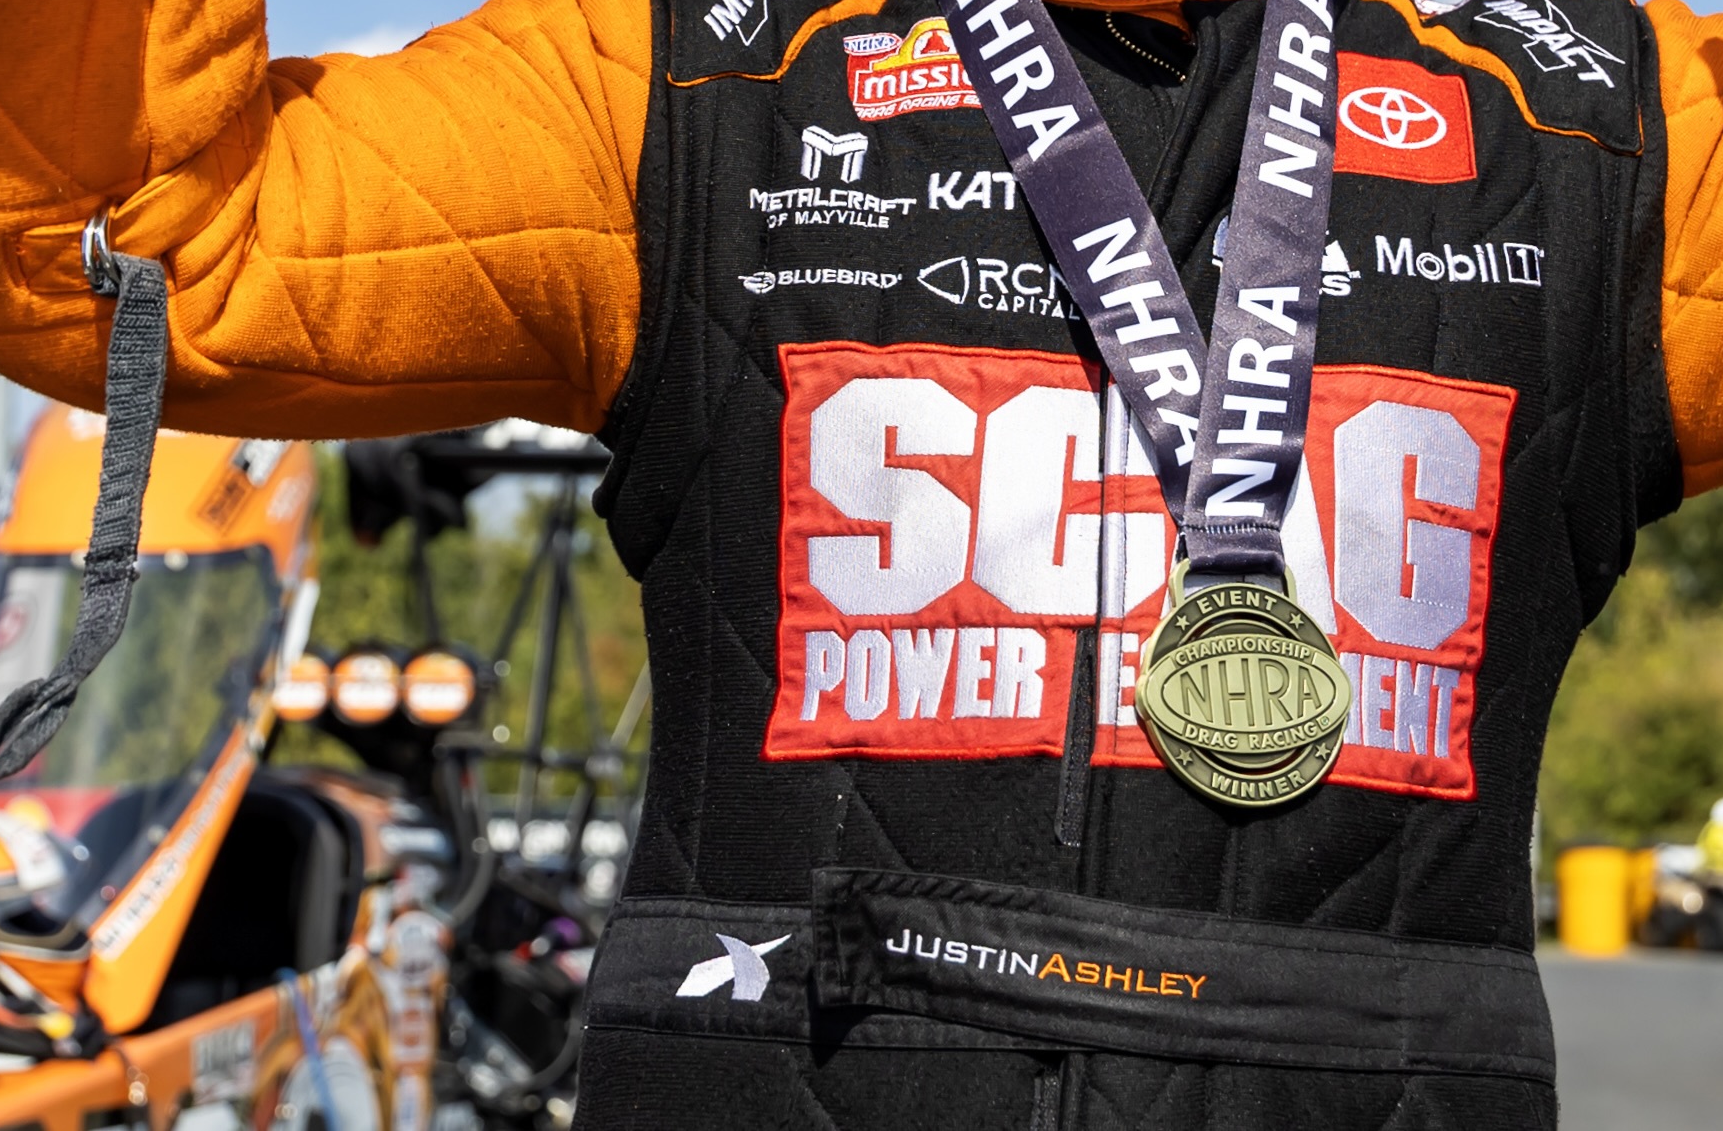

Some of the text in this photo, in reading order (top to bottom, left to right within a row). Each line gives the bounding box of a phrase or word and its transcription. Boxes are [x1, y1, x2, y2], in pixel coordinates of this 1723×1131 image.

[844, 35, 895, 53] NHRA
[864, 63, 973, 100] MISSI
[898, 94, 960, 111] RACING
[749, 188, 917, 215] METALCRAFT
[928, 170, 1019, 211] KAT
[767, 210, 890, 229] OF MAYVILLE
[1375, 235, 1501, 284] Mobil
[777, 268, 899, 289] BLUEBIRD
[977, 293, 1081, 320] CAPITAL
[1072, 217, 1200, 467] NHRA
[1204, 285, 1301, 518] NHRA
[1196, 590, 1277, 614] EVENT
[1175, 637, 1312, 667] CHAMPIONSHIP
[799, 626, 1048, 723] POWER
[1179, 657, 1322, 727] NHRA
[1184, 720, 1319, 750] DRAG RACING
[1211, 769, 1306, 799] WINNER
